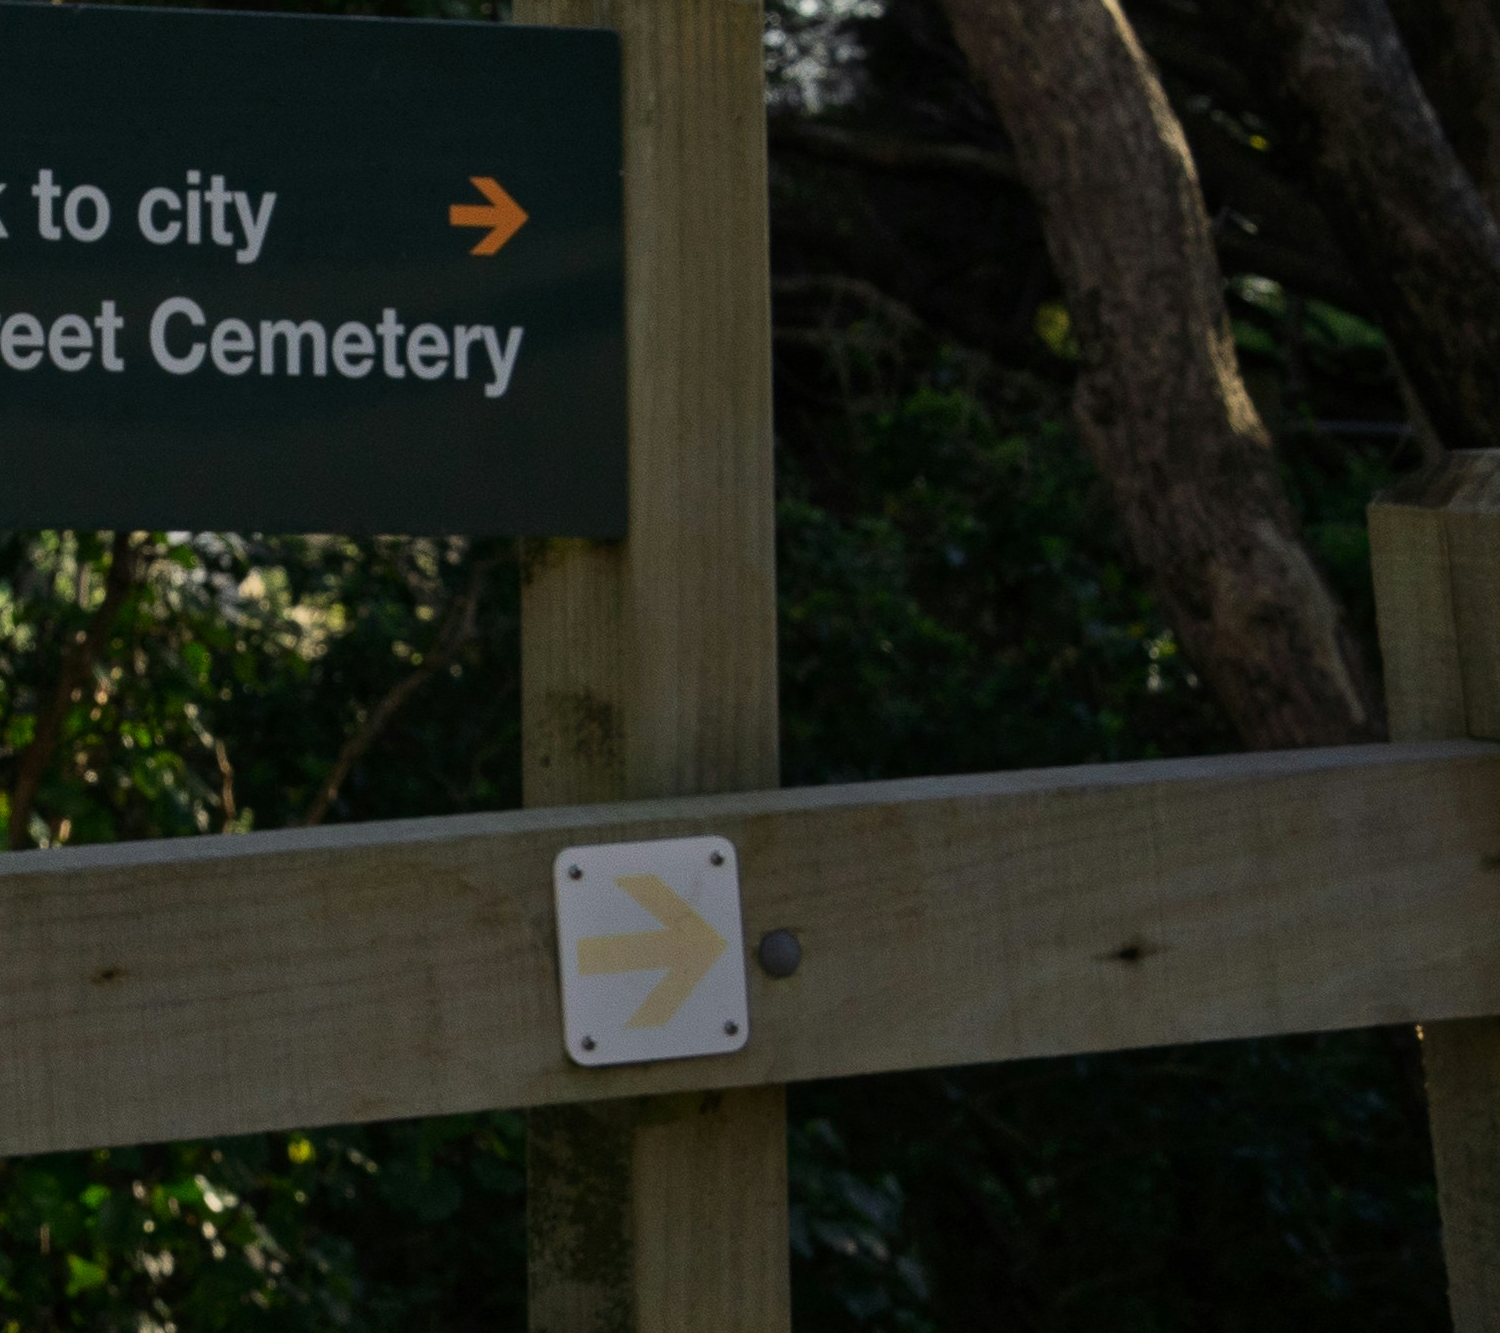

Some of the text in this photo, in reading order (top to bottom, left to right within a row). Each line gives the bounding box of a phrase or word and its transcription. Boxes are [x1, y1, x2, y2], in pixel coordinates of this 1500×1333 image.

[31, 168, 111, 242] to
[138, 169, 278, 265] city
[149, 296, 524, 399] Cemetery
